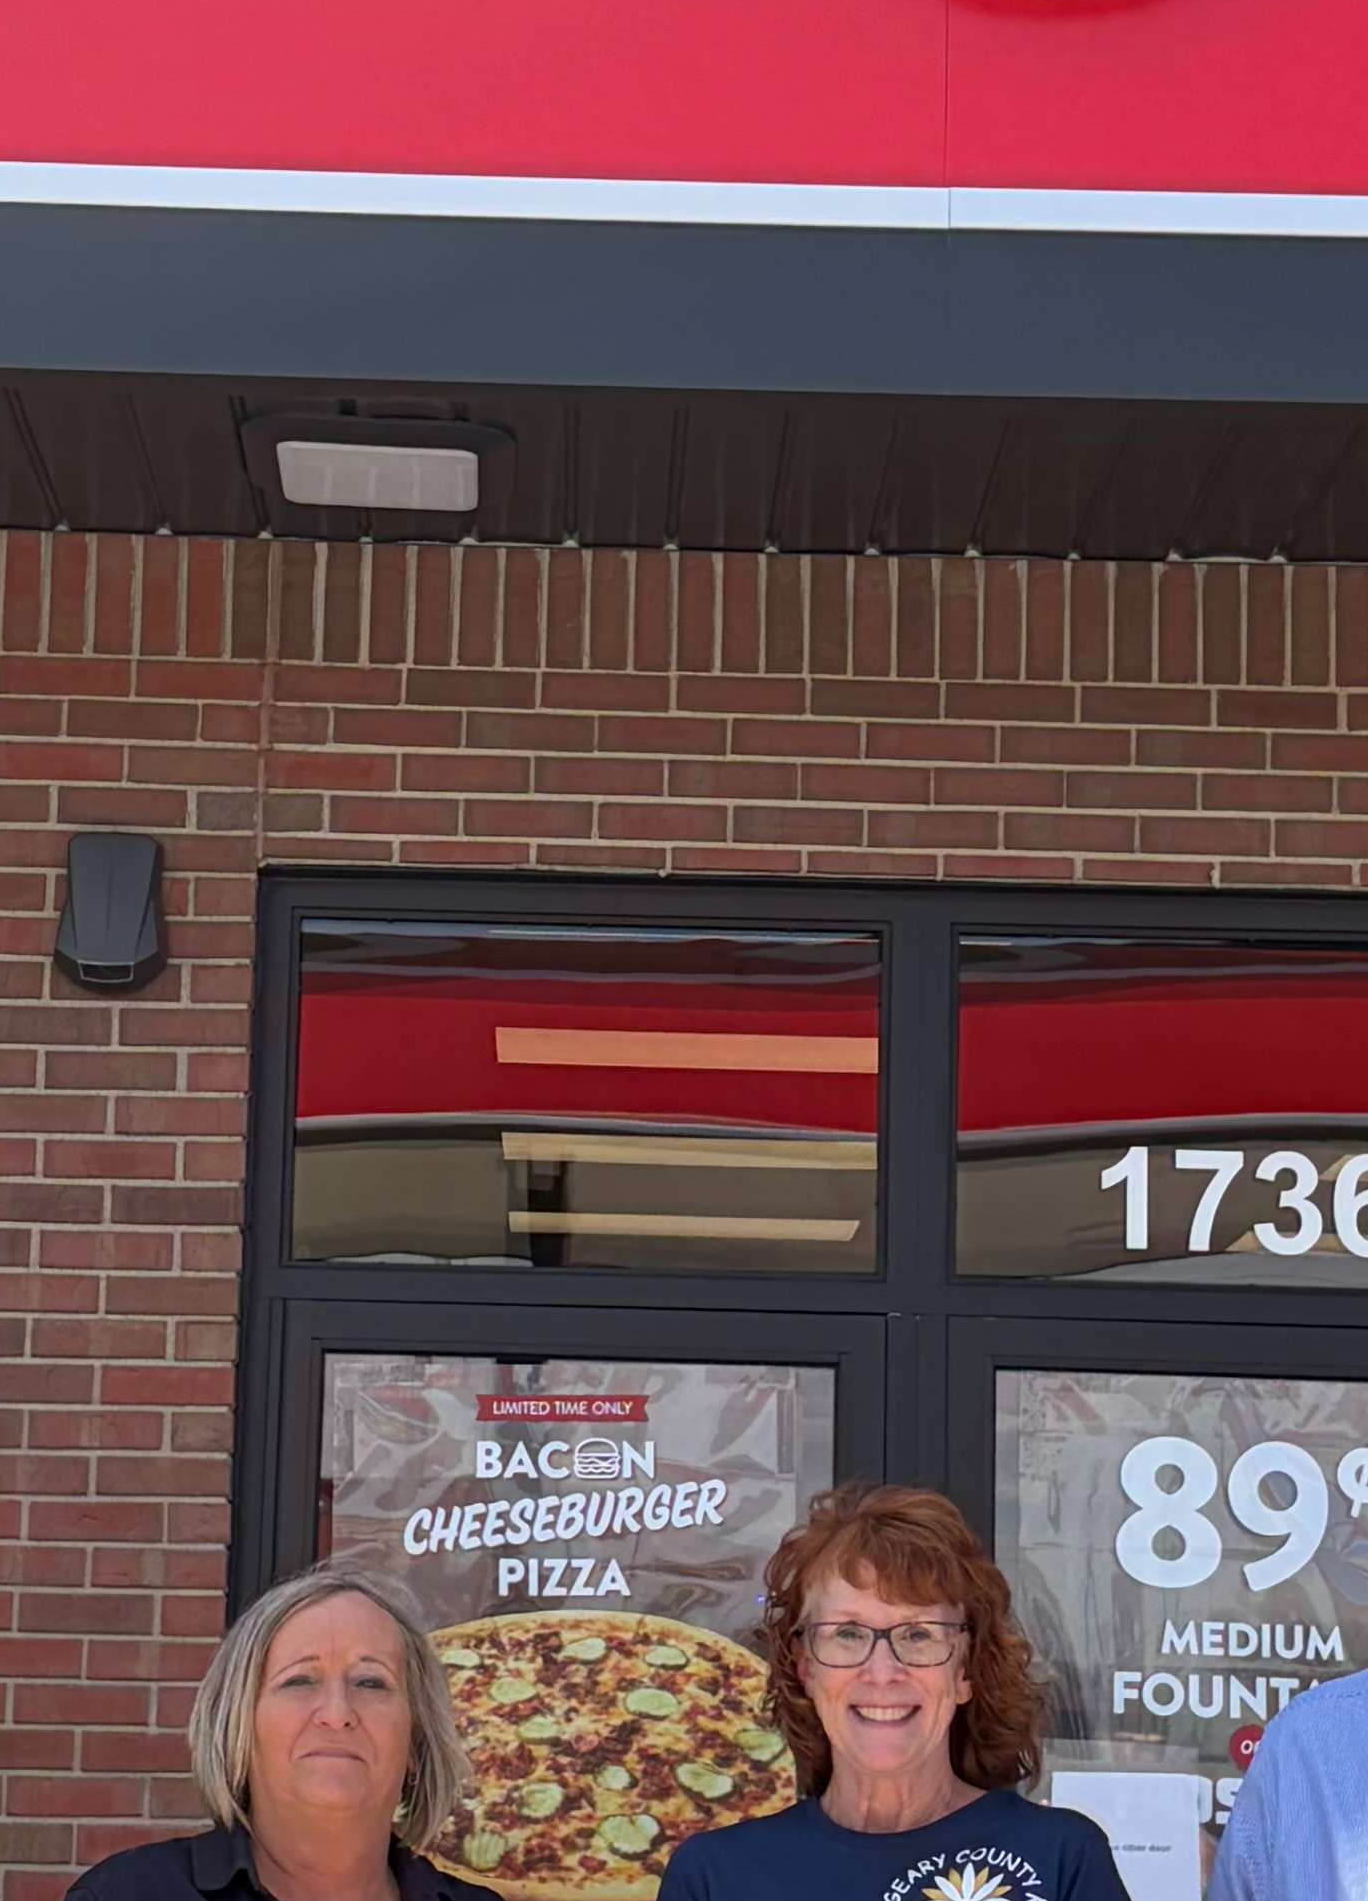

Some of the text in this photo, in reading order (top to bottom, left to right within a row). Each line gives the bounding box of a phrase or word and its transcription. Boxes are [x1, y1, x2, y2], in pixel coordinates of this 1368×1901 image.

[492, 1402, 632, 1415] LIMITED TIME ONLY
[403, 1479, 728, 1556] CHEESEBURGER
[498, 1558, 632, 1597] PIZZA
[1161, 1619, 1345, 1662] MEDIUM
[1112, 1671, 1321, 1721] FOUNT
[955, 1847, 1043, 1887] COUNTY
